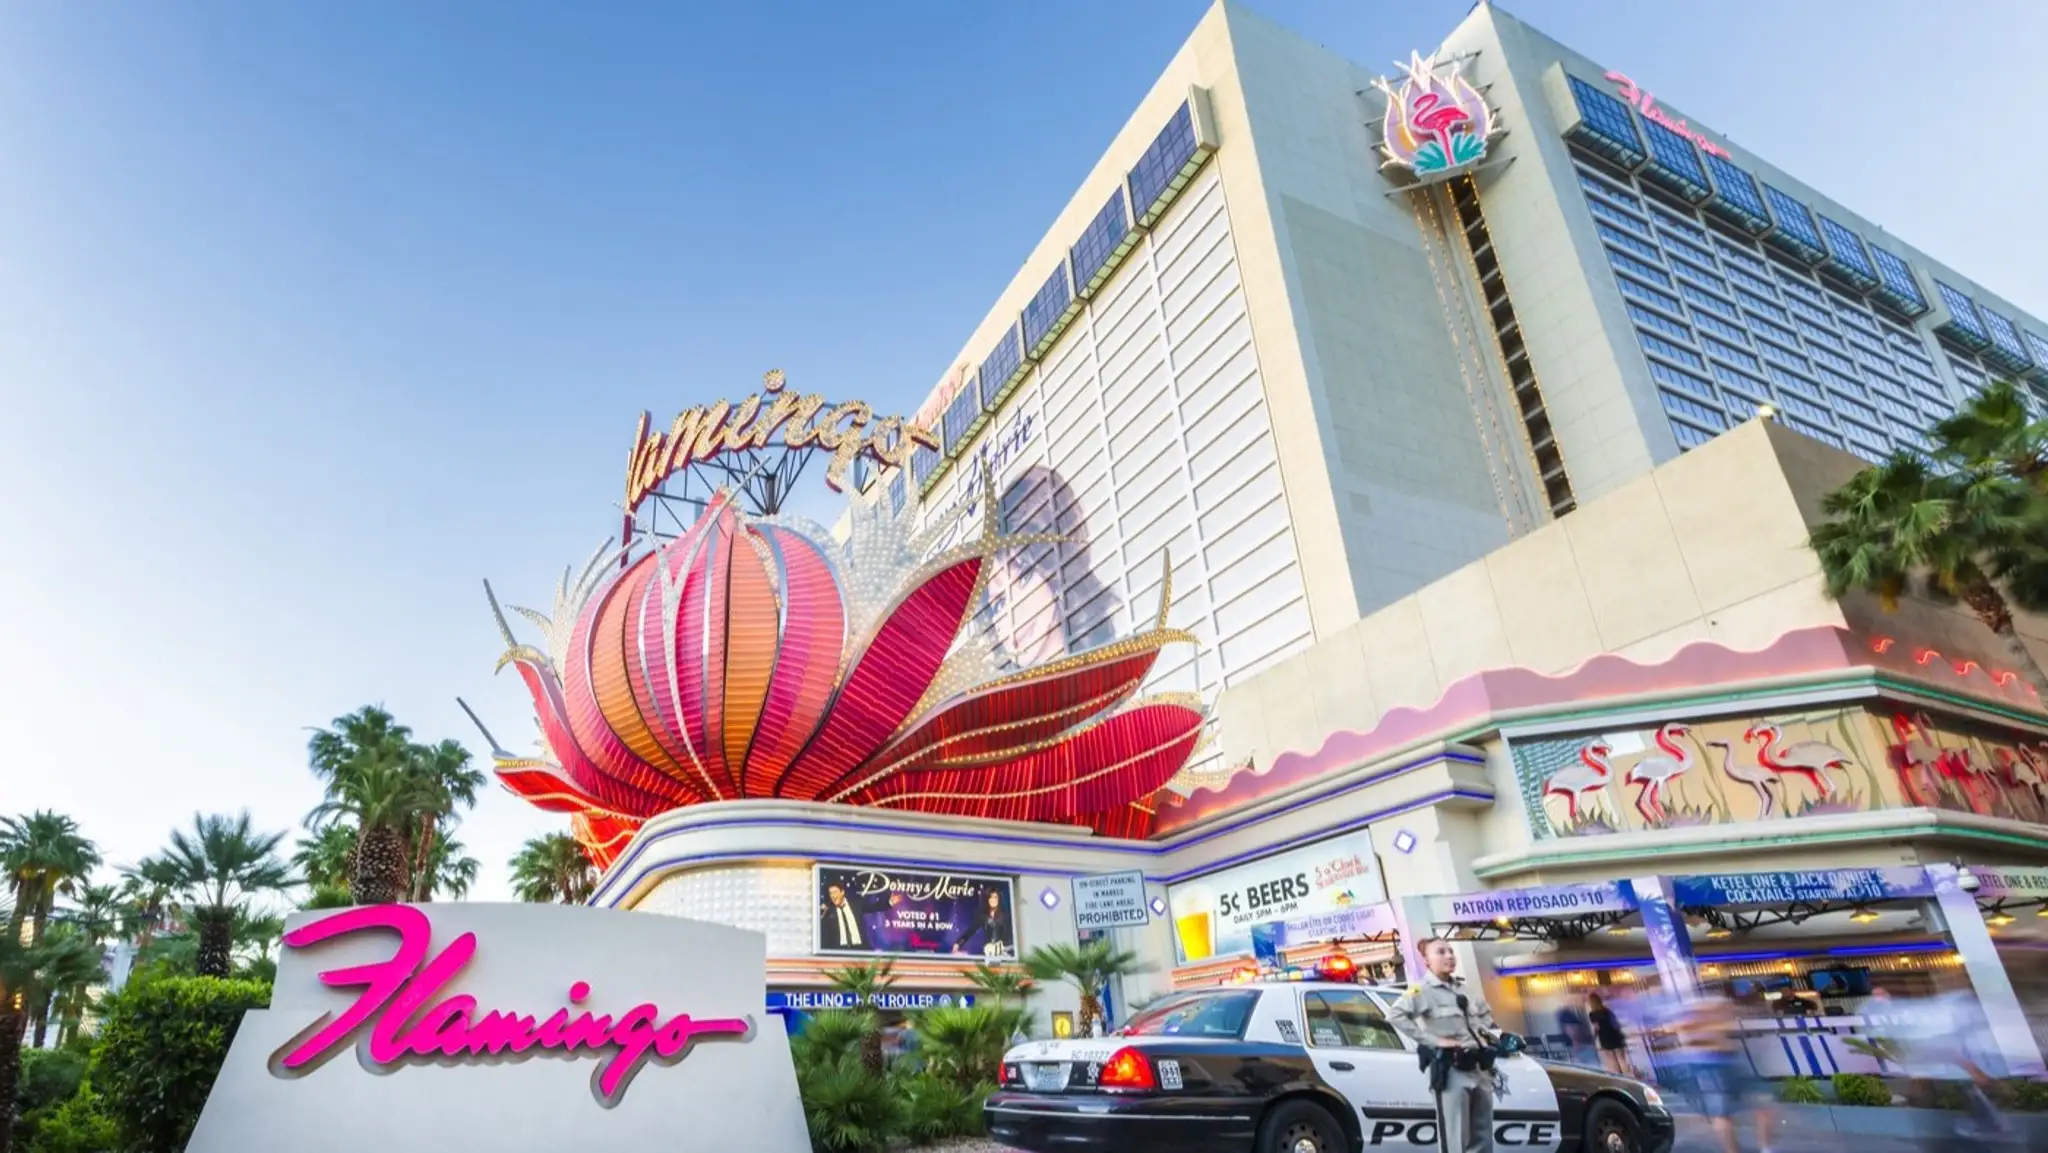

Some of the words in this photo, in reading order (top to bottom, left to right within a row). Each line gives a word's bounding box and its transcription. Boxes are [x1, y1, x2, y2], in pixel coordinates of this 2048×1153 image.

[856, 870, 925, 898] Donny
[907, 876, 975, 900] Marie
[1711, 875, 1750, 890] KETEL
[1751, 874, 1778, 888] ONE
[1780, 872, 1790, 886] &
[1794, 871, 1828, 886] JACK
[1219, 891, 1241, 917] 5¢
[1247, 873, 1309, 909] BEERS
[1453, 896, 1506, 915] PATRÓN
[1508, 893, 1578, 912] REPOSADO
[1725, 886, 1795, 903] COCKTAILS
[892, 920, 915, 929] YEARS
[917, 921, 926, 930] IN
[897, 911, 926, 920] VOTED
[1079, 909, 1144, 924] PROHIBITED
[281, 904, 749, 1099] Flamingo
[785, 993, 811, 1007] THE
[855, 994, 884, 1008] HGH
[888, 994, 934, 1008] ROLLER
[1370, 1121, 1556, 1146] POCE
